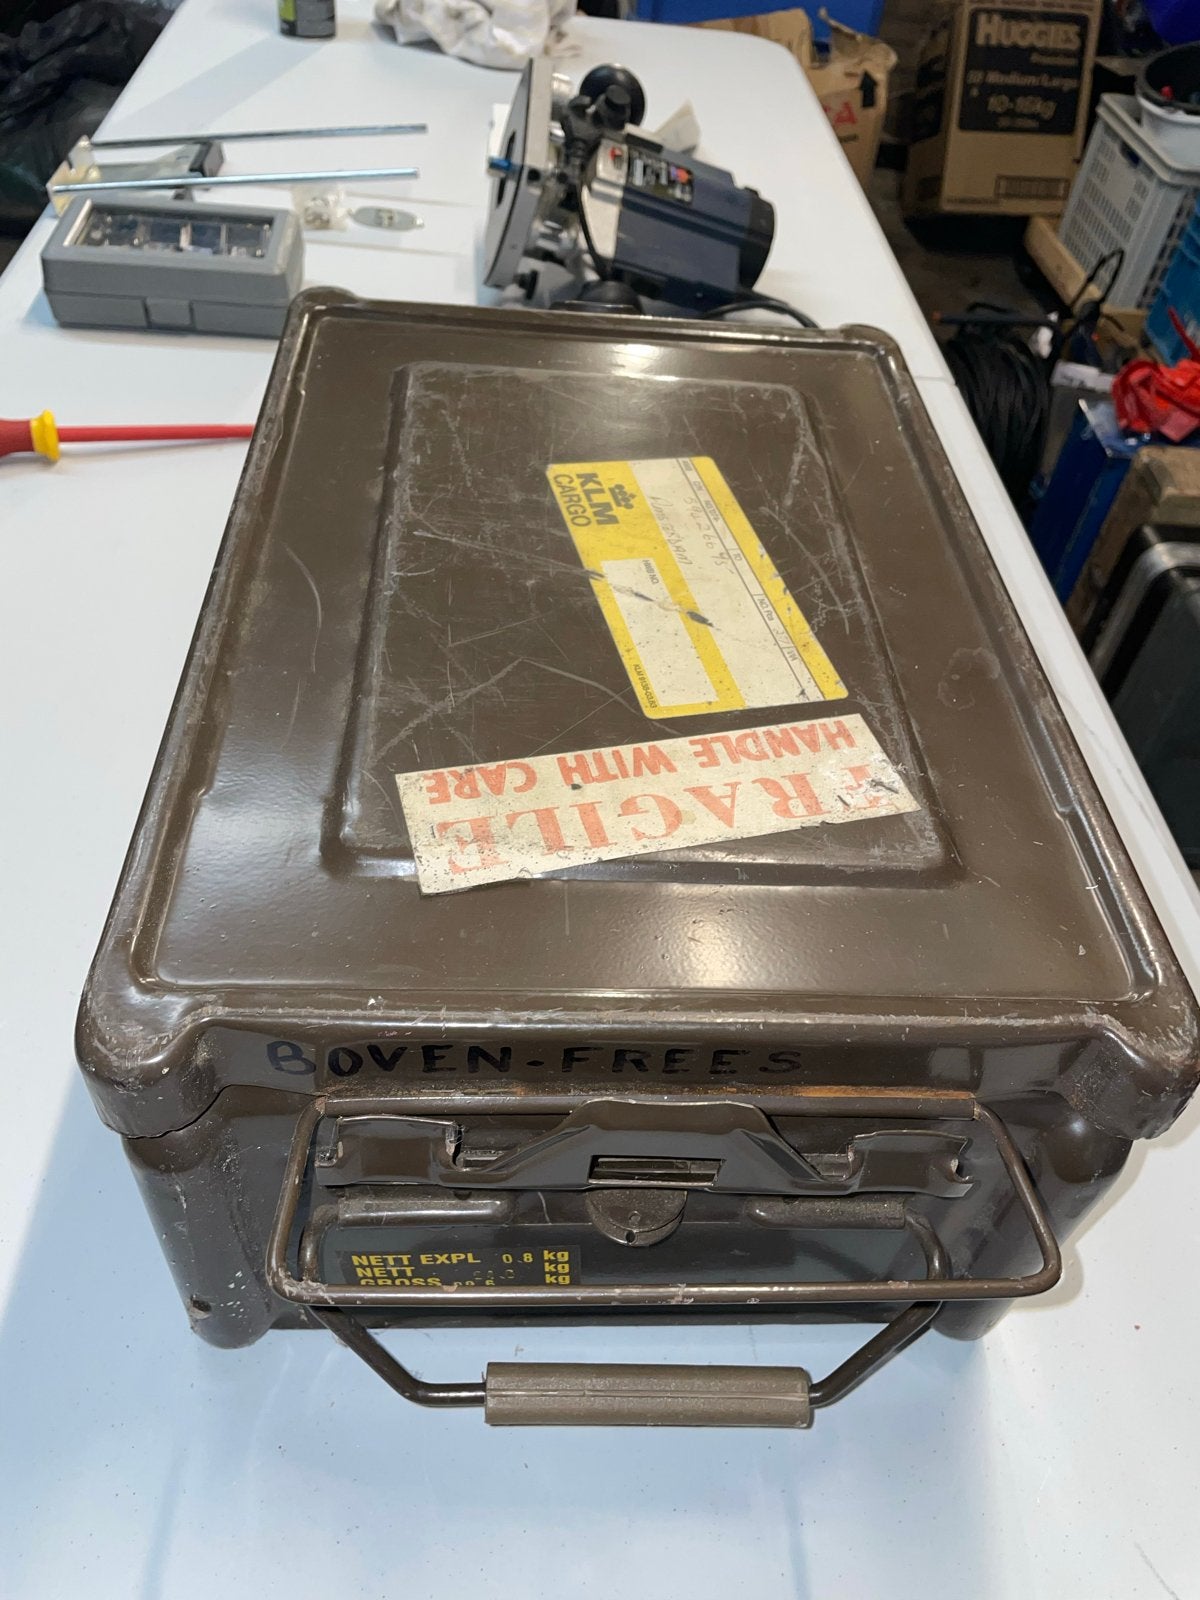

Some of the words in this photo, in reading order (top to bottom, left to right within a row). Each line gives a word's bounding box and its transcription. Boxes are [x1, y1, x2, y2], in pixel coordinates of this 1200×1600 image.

[975, 13, 1081, 49] HUGGIES
[553, 473, 592, 527] CARGO
[576, 473, 620, 525] KLM
[692, 719, 858, 768] HANDLE
[424, 762, 538, 805] CARE
[557, 745, 678, 788] WITH
[436, 764, 893, 874] FRAGILE
[351, 1255, 412, 1266] NETT
[420, 1253, 481, 1264] EXPL
[543, 1250, 569, 1262] kg
[356, 1267, 415, 1277] NETT
[544, 1262, 570, 1273] kg
[545, 1274, 571, 1285] kg
